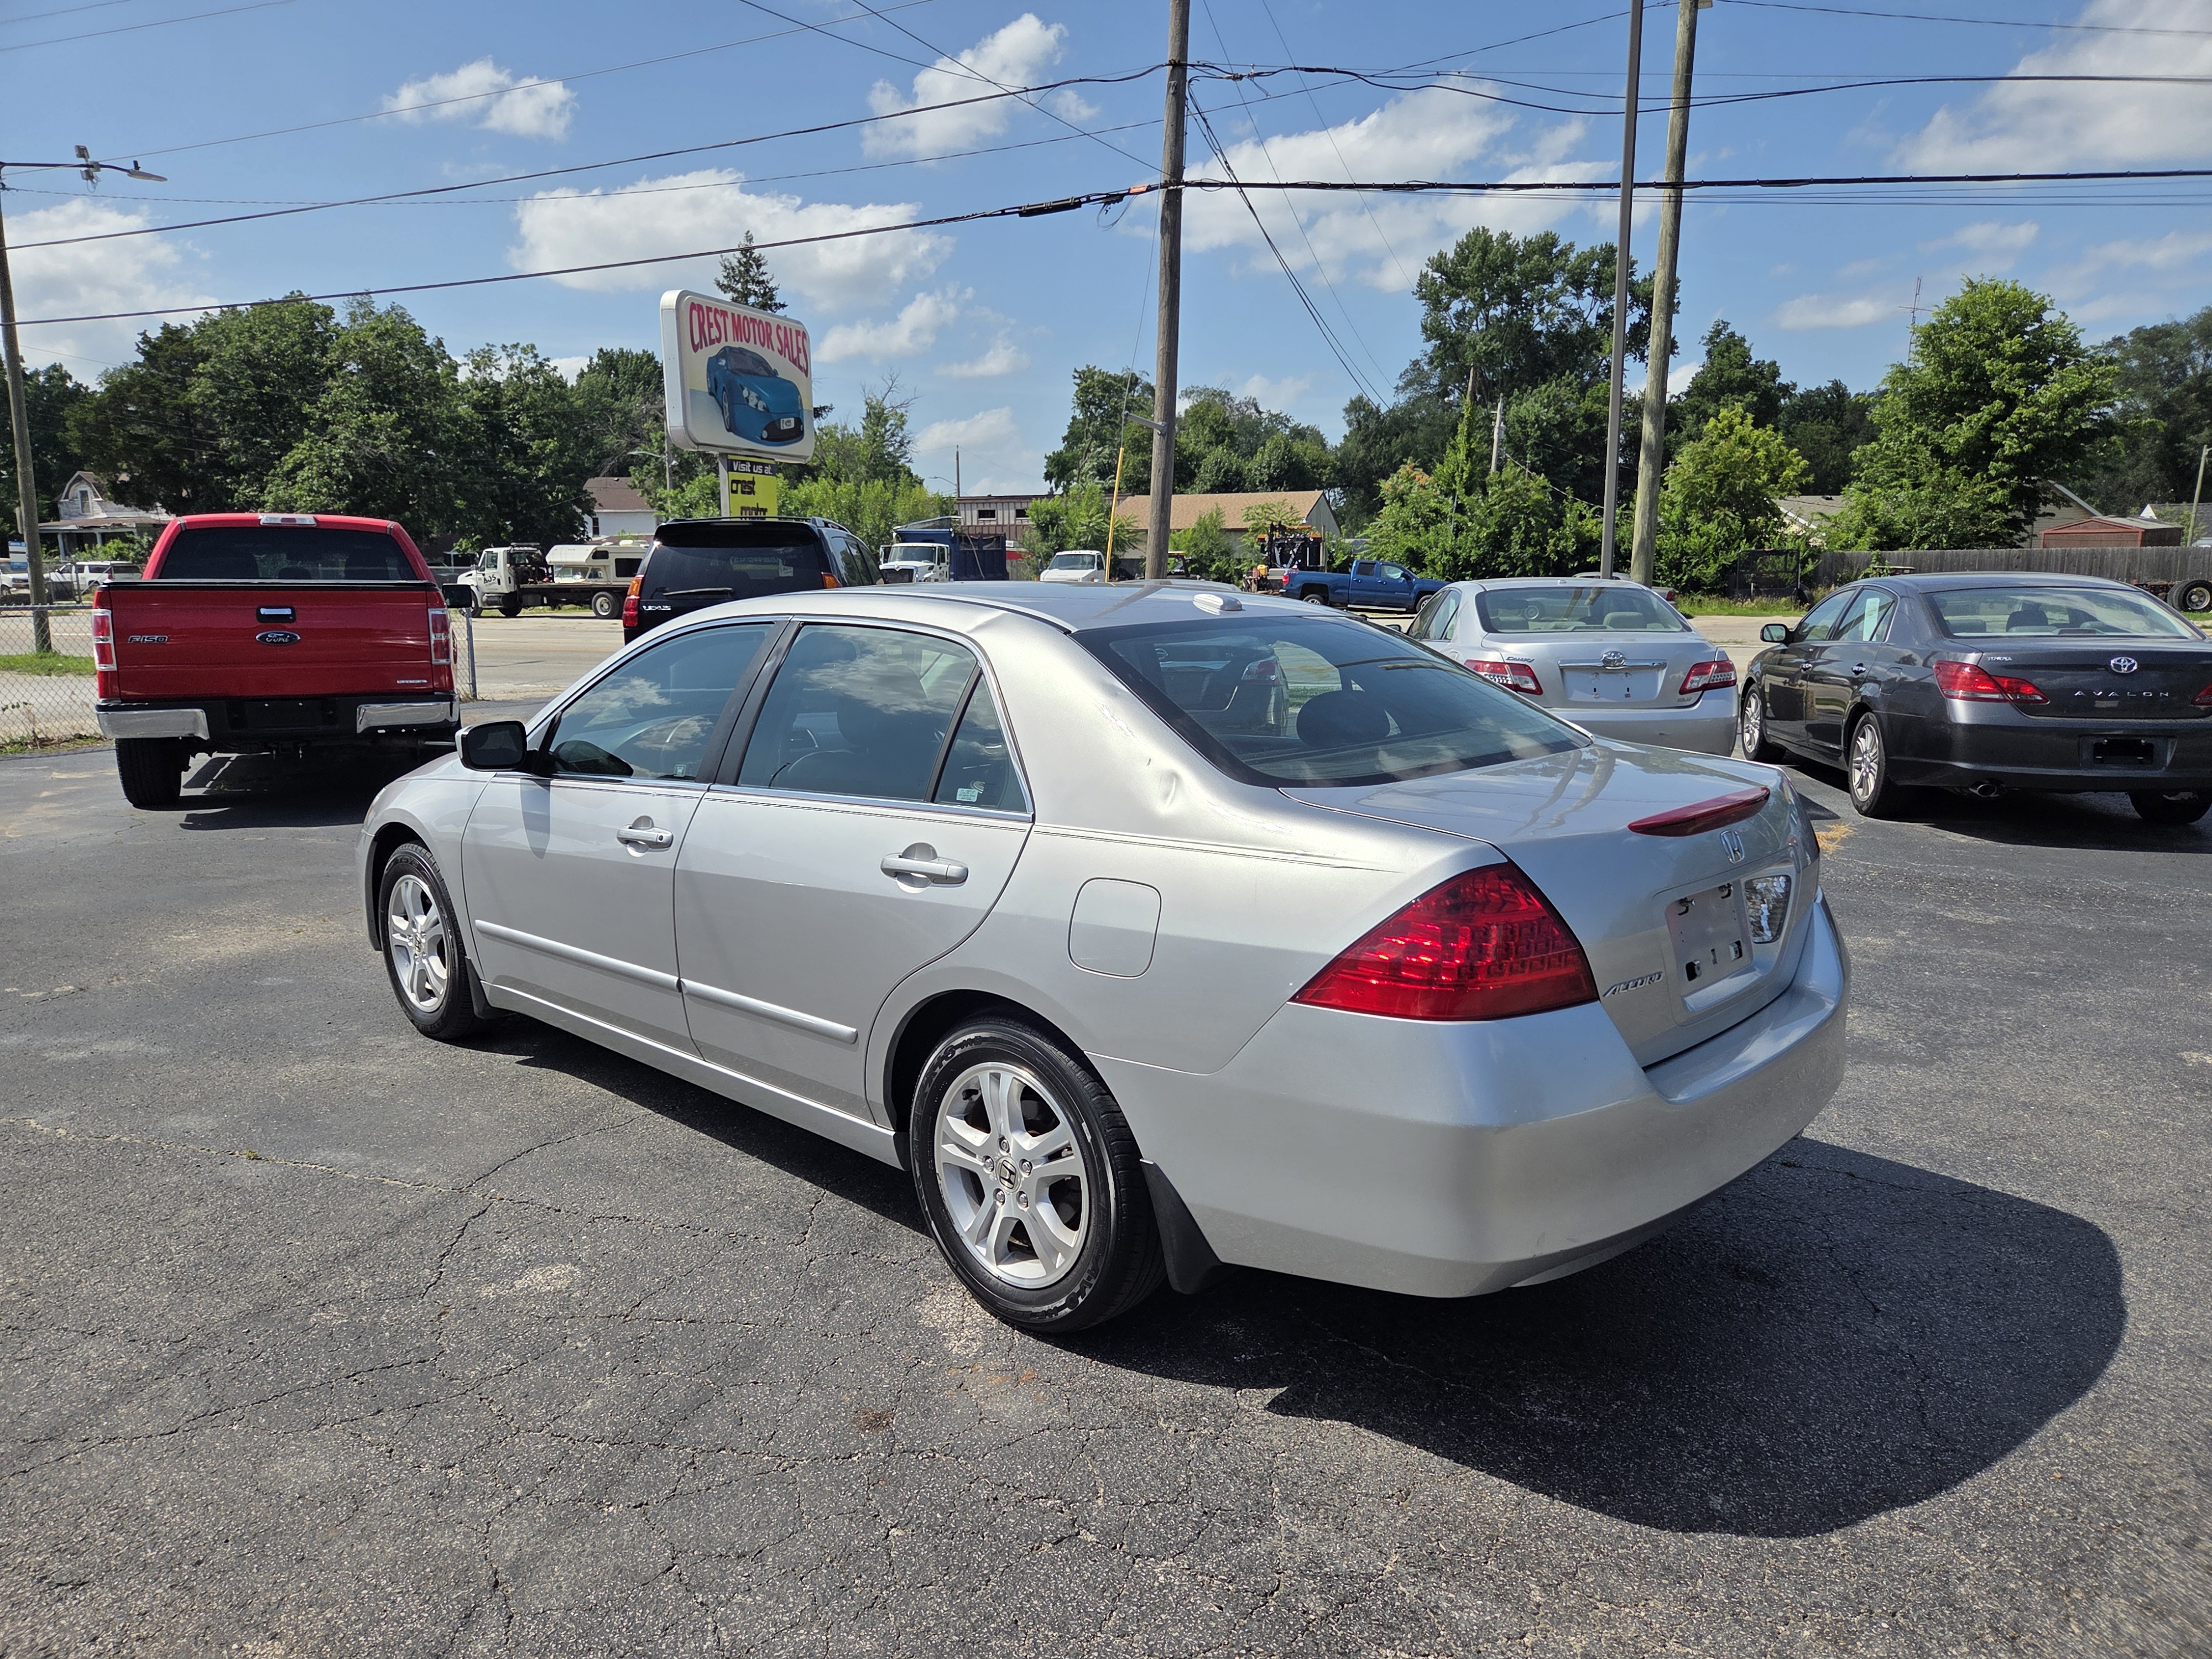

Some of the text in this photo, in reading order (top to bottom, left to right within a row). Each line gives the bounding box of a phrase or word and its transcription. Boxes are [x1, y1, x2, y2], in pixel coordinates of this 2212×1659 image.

[689, 301, 809, 378] CREST MOTOR SALES
[733, 461, 751, 472] Visit
[753, 465, 763, 473] us
[731, 476, 755, 495] crest
[1603, 971, 1663, 997] ACCORD
